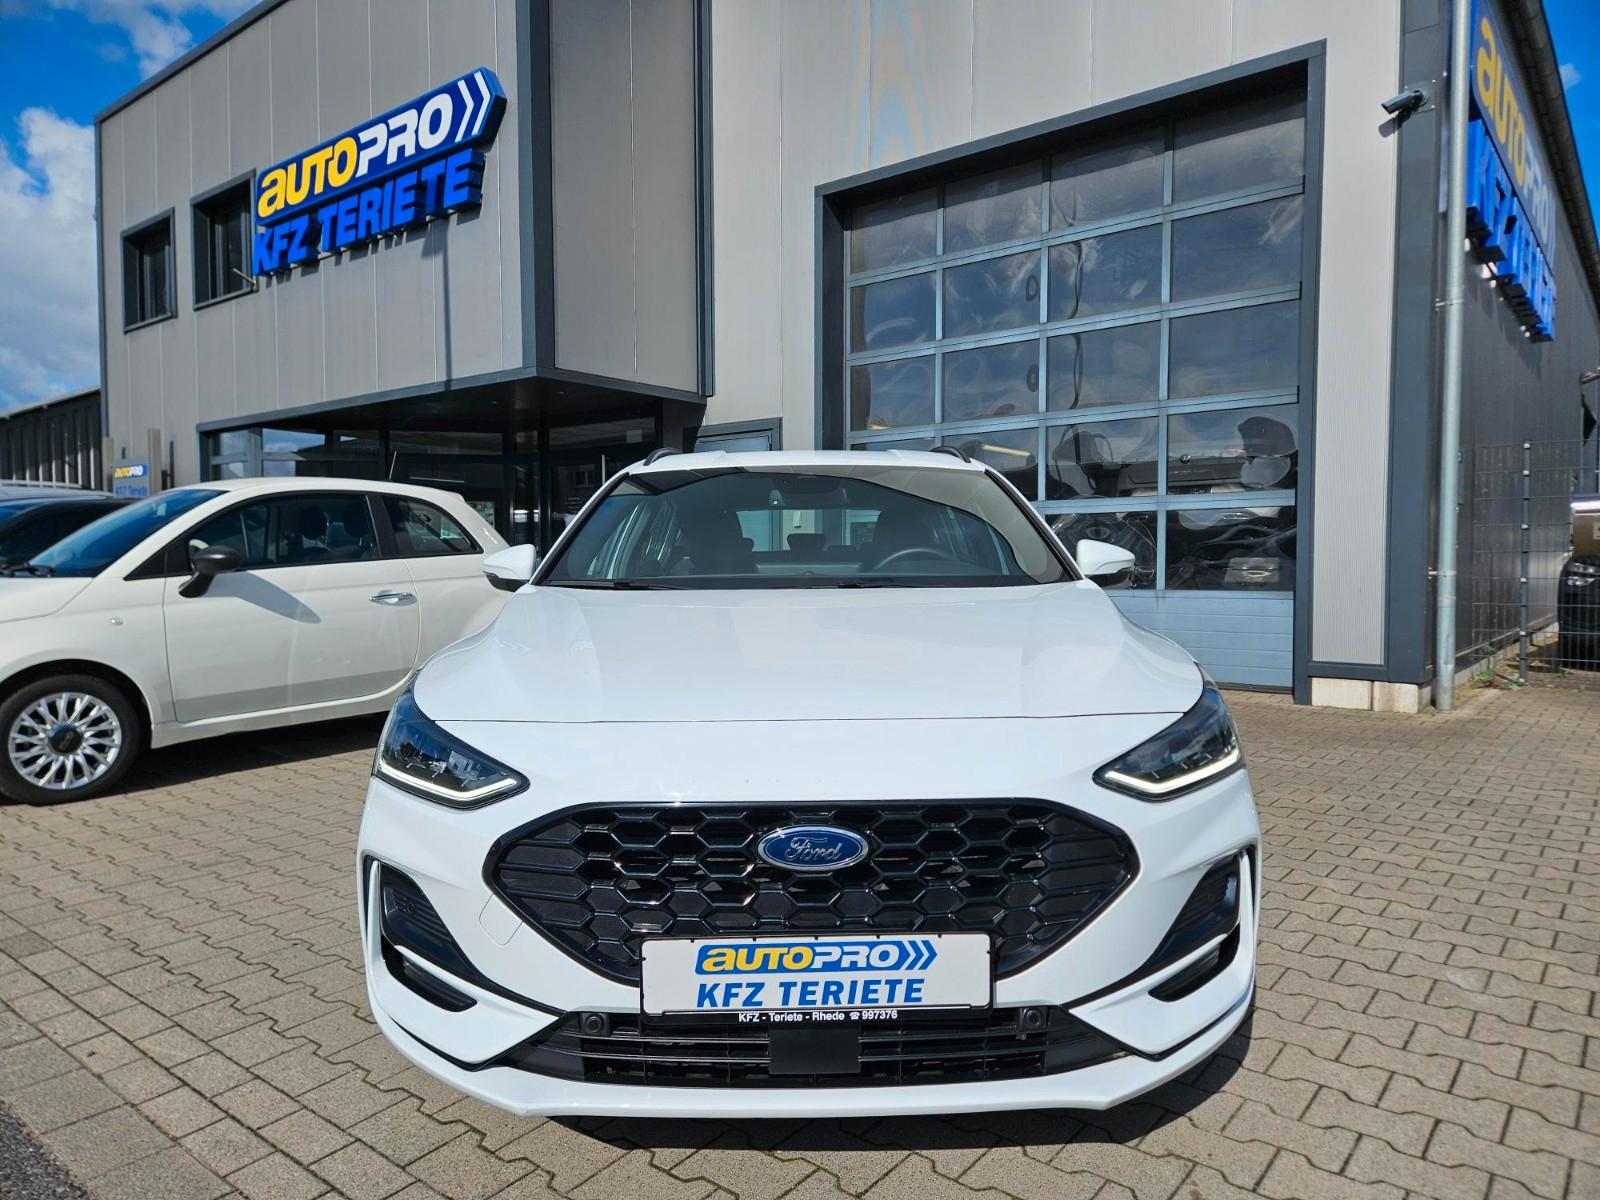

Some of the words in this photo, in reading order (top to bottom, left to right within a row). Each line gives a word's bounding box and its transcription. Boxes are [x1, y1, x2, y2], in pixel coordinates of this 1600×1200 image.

[252, 213, 310, 277] KFZ
[318, 148, 473, 253] TERIETE
[784, 836, 843, 861] Ford
[696, 982, 766, 1008] KFZ
[779, 978, 925, 1006] TERIETE
[738, 1012, 760, 1023] KFZ
[769, 1011, 803, 1022] Teriete
[812, 1010, 845, 1022] Rhede
[861, 1009, 898, 1020] 997376
